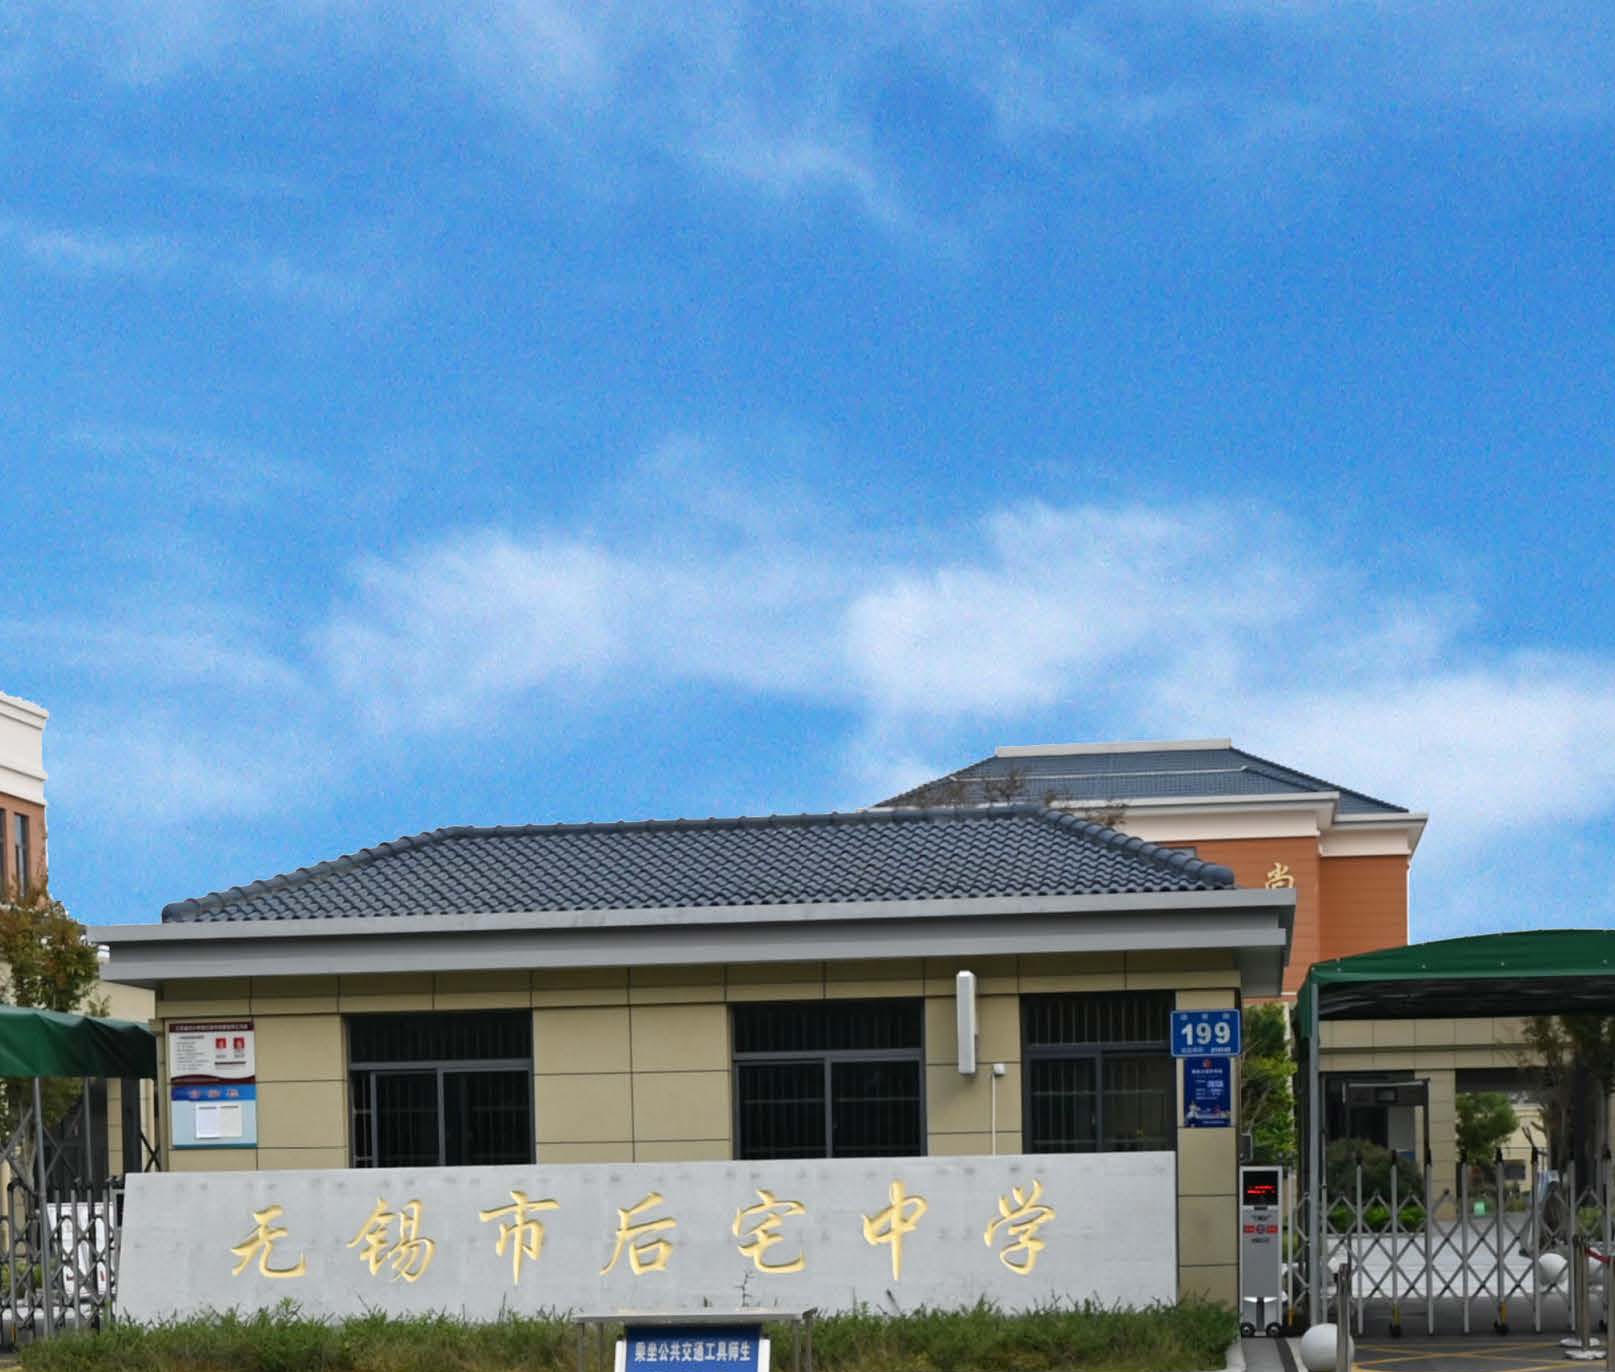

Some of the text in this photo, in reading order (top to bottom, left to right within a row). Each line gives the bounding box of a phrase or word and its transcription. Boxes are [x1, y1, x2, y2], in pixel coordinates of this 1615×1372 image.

[1181, 1021, 1231, 1046] 199
[230, 1178, 1057, 1284] 无锡市后宅中学
